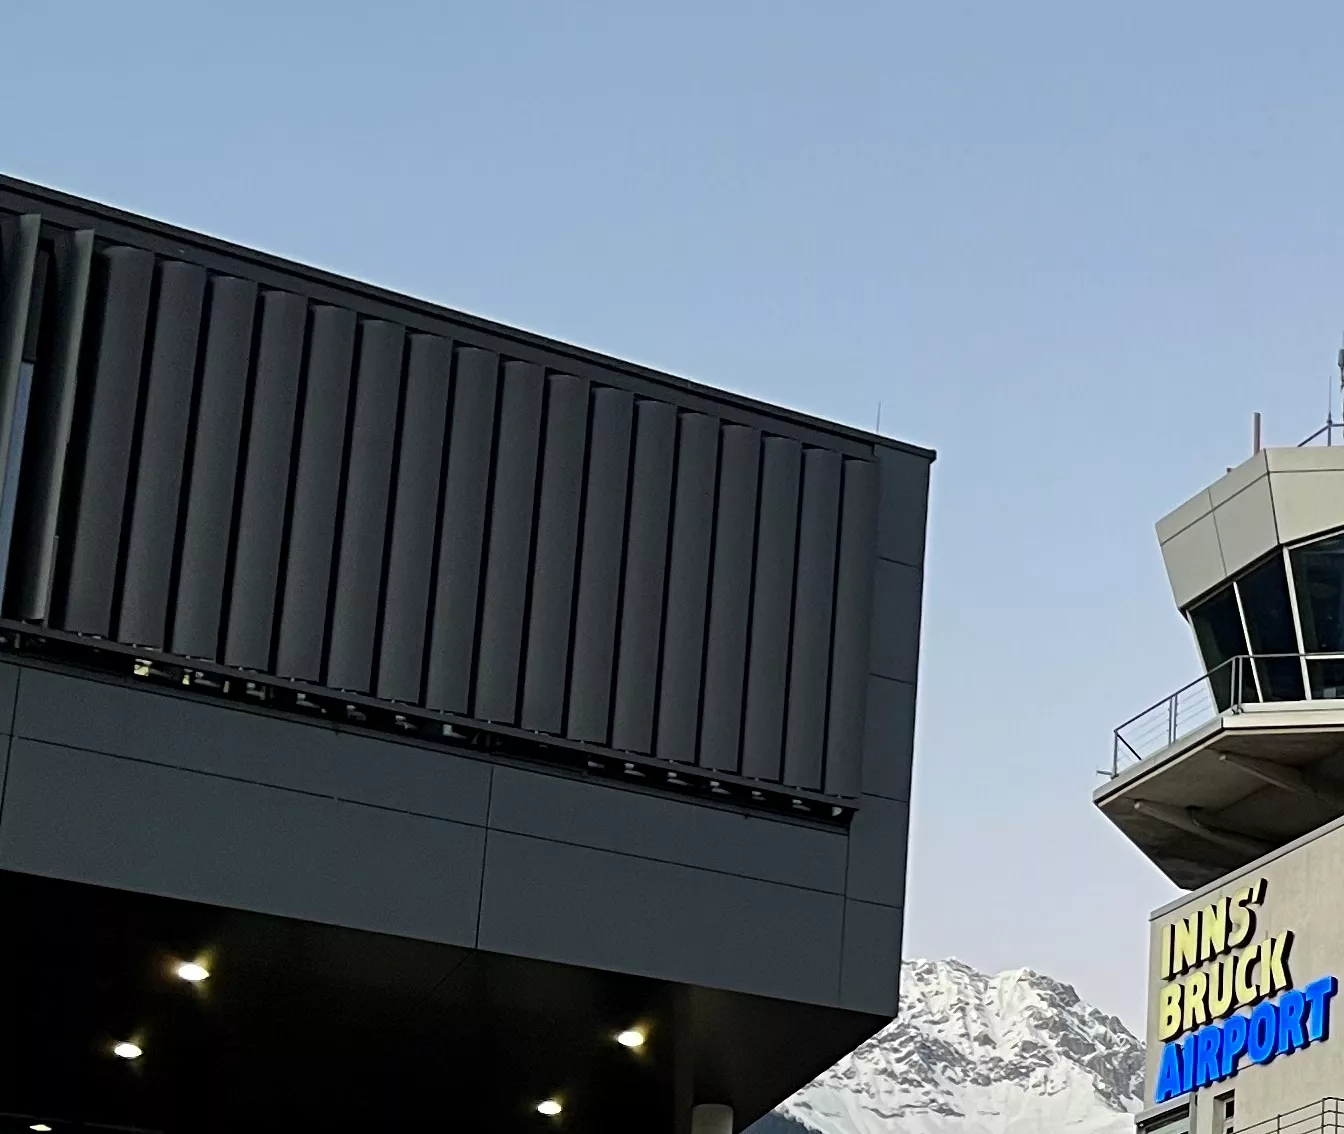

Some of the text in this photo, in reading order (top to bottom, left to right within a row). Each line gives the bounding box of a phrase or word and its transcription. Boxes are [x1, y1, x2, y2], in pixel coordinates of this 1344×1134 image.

[1160, 878, 1268, 980] INNS'
[1154, 975, 1338, 1104] AIRPORT
[1158, 930, 1295, 1042] BRUCK
